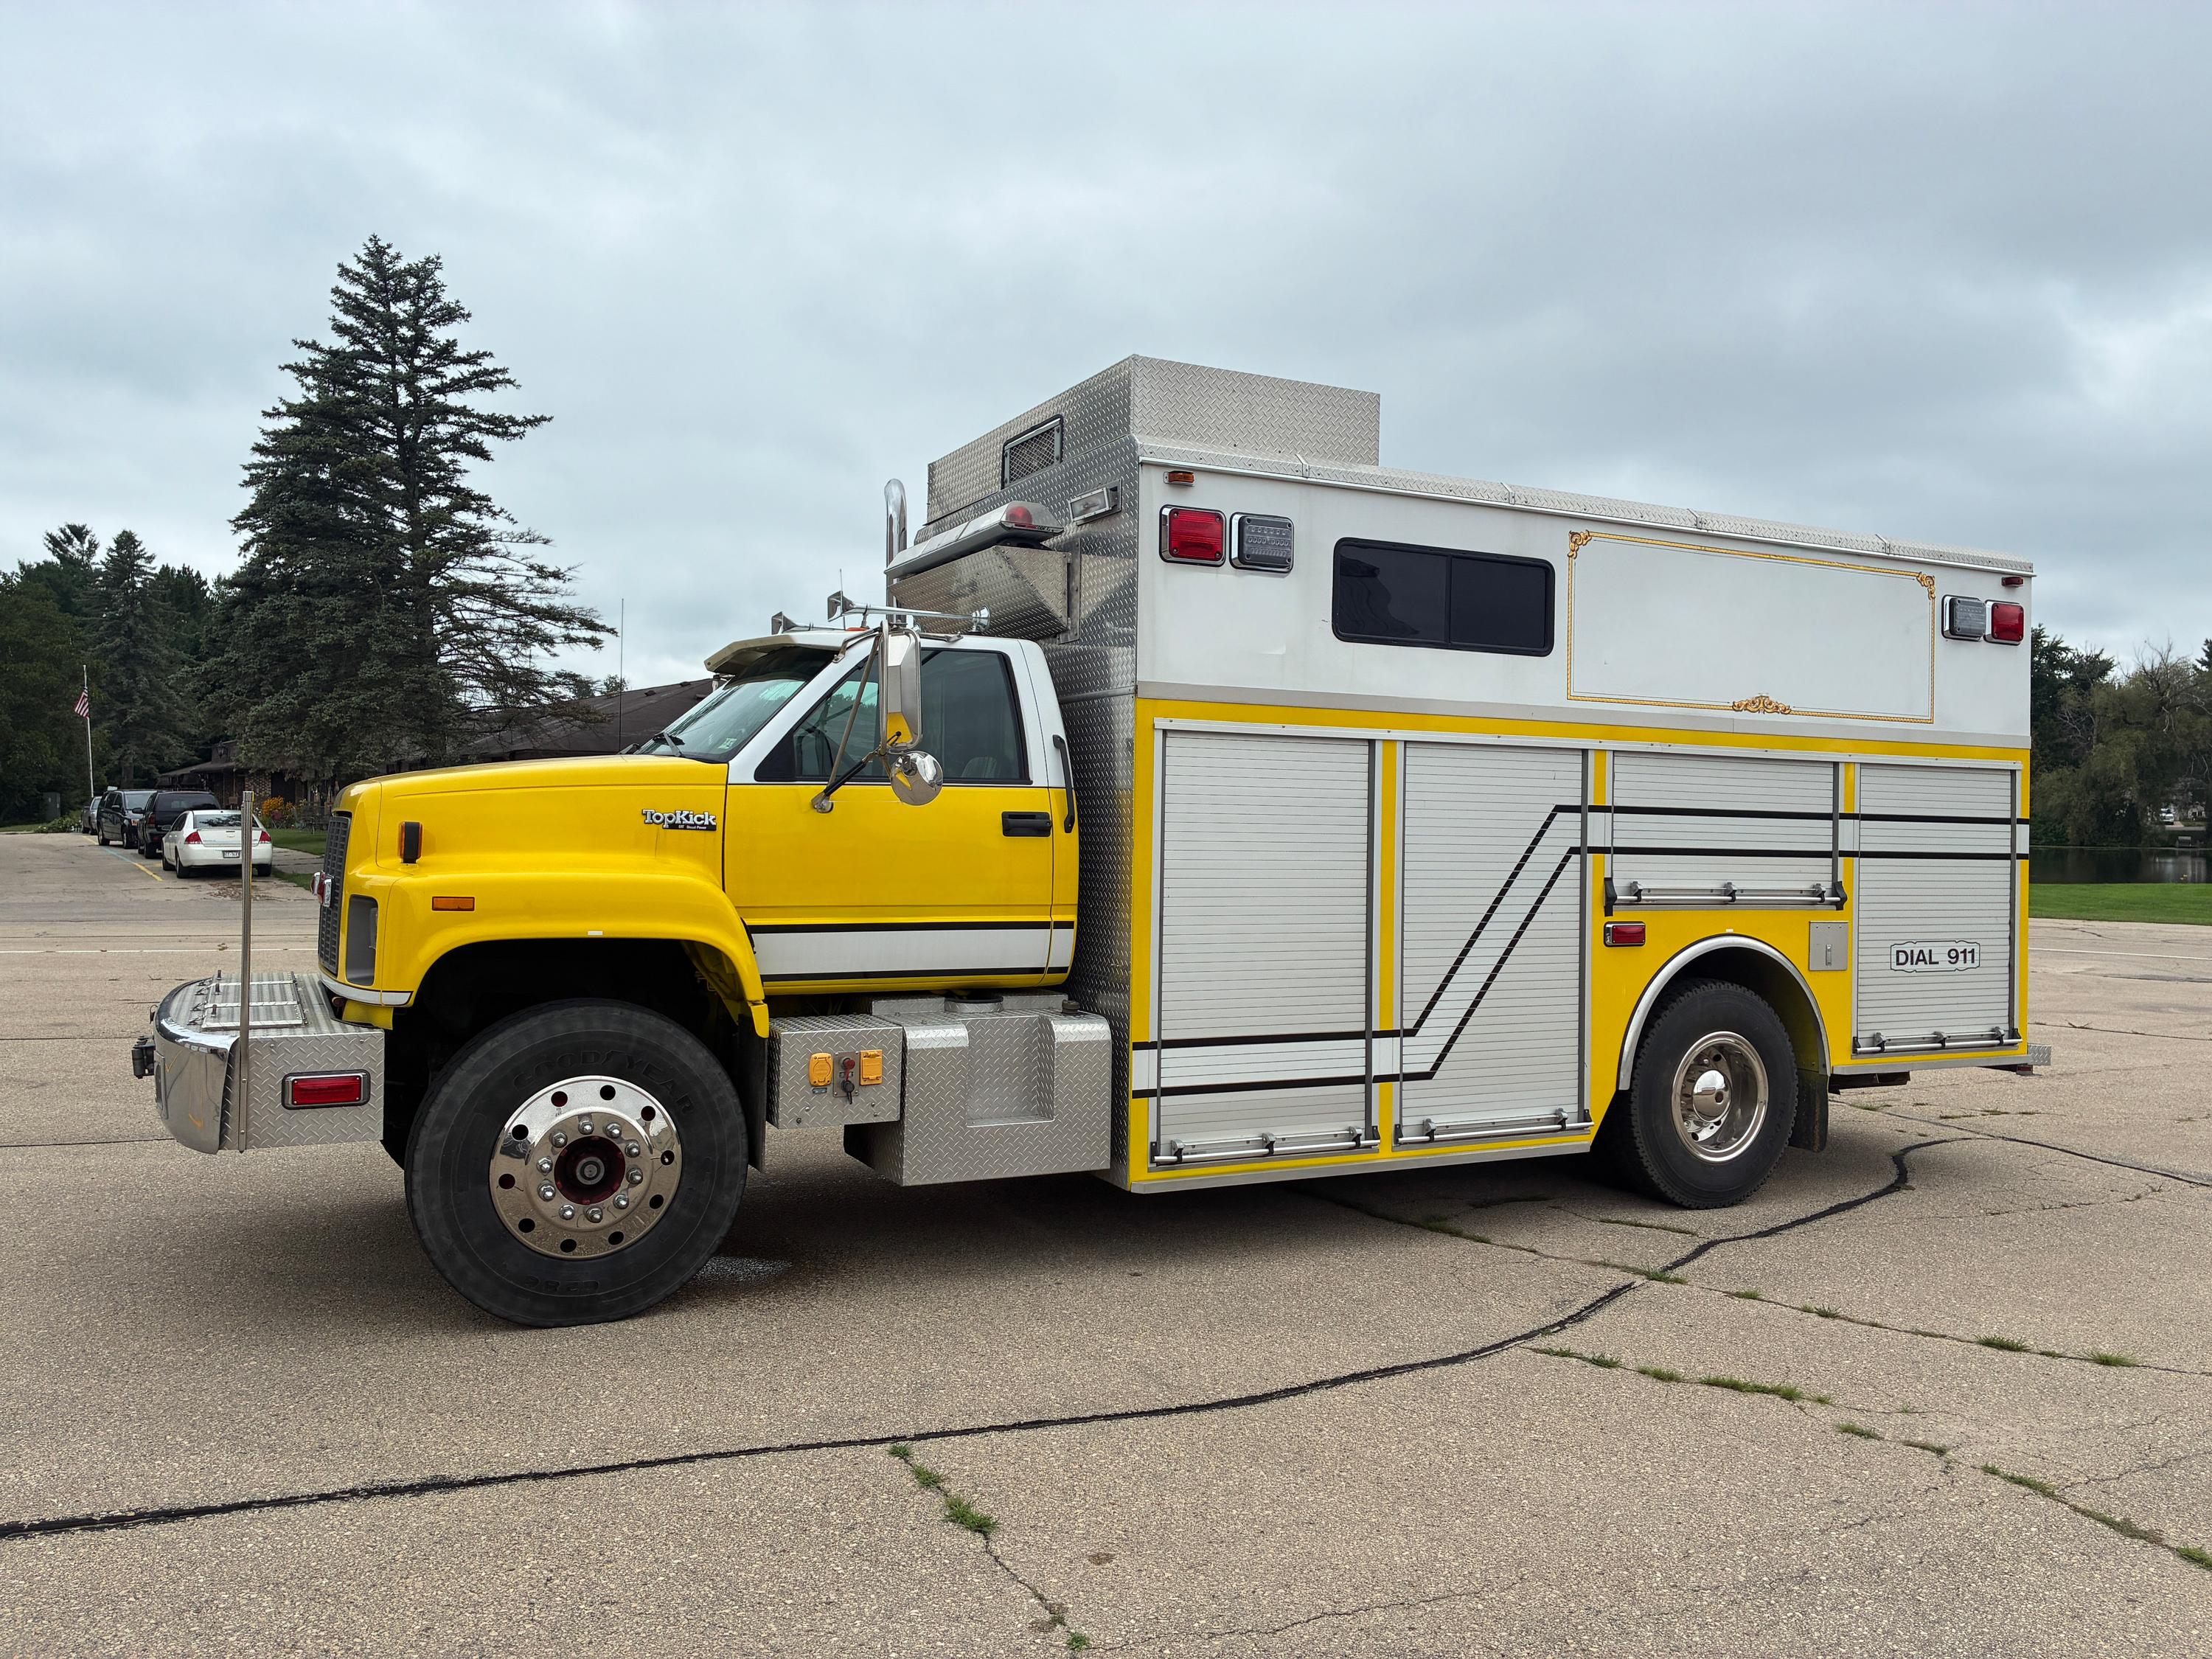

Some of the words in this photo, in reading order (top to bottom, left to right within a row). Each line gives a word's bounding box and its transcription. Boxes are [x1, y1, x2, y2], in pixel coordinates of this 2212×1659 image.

[642, 809, 717, 828] TopKick
[1896, 949, 1939, 966] DIAL
[1947, 948, 1975, 964] 911
[513, 1049, 694, 1114] GOODYEAR
